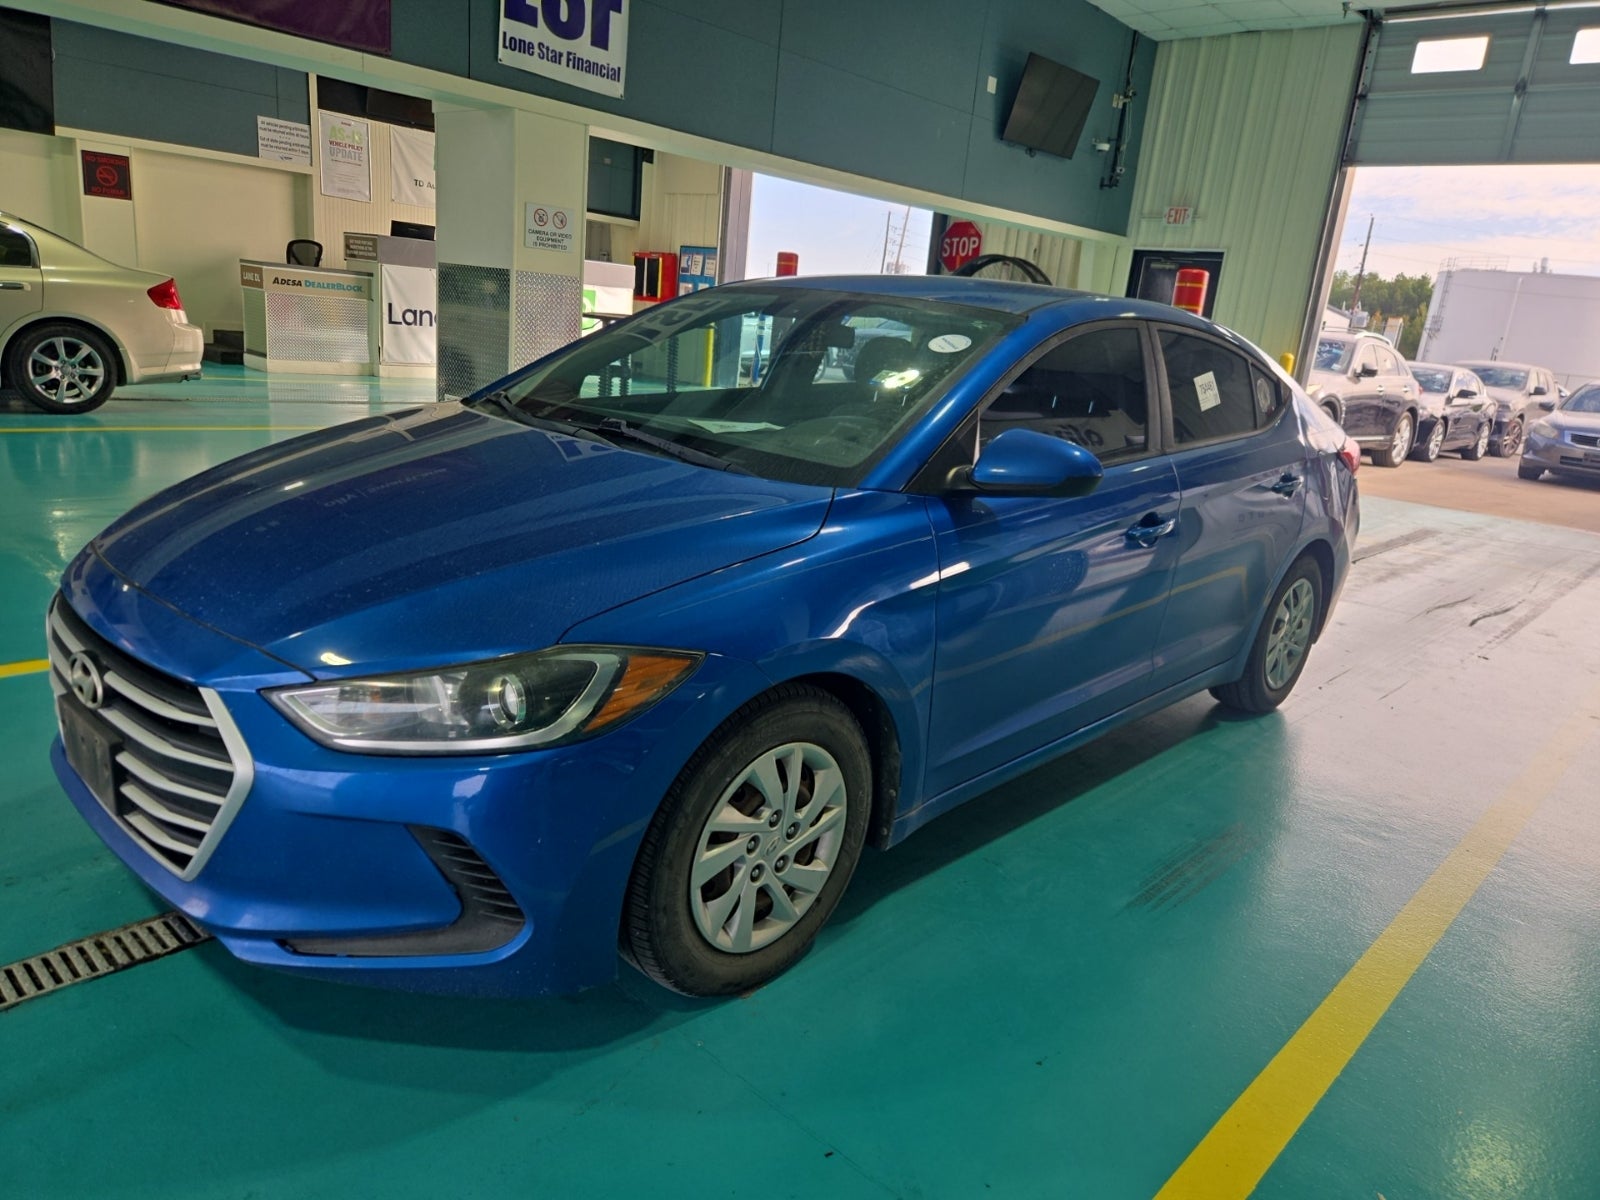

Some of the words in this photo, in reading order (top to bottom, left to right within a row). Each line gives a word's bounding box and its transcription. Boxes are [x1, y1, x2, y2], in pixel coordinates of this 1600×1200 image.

[502, 31, 535, 57] Lone
[537, 41, 564, 66] Star
[566, 50, 621, 83] Financial
[328, 139, 347, 149] VEHICLE
[347, 143, 363, 152] POLICY
[329, 147, 363, 161] UPDATE
[413, 178, 424, 187] TD
[1167, 207, 1189, 224] EXIT
[539, 242, 567, 250] PROHIBITED
[942, 236, 980, 257] STOP
[388, 302, 437, 327] Lan
